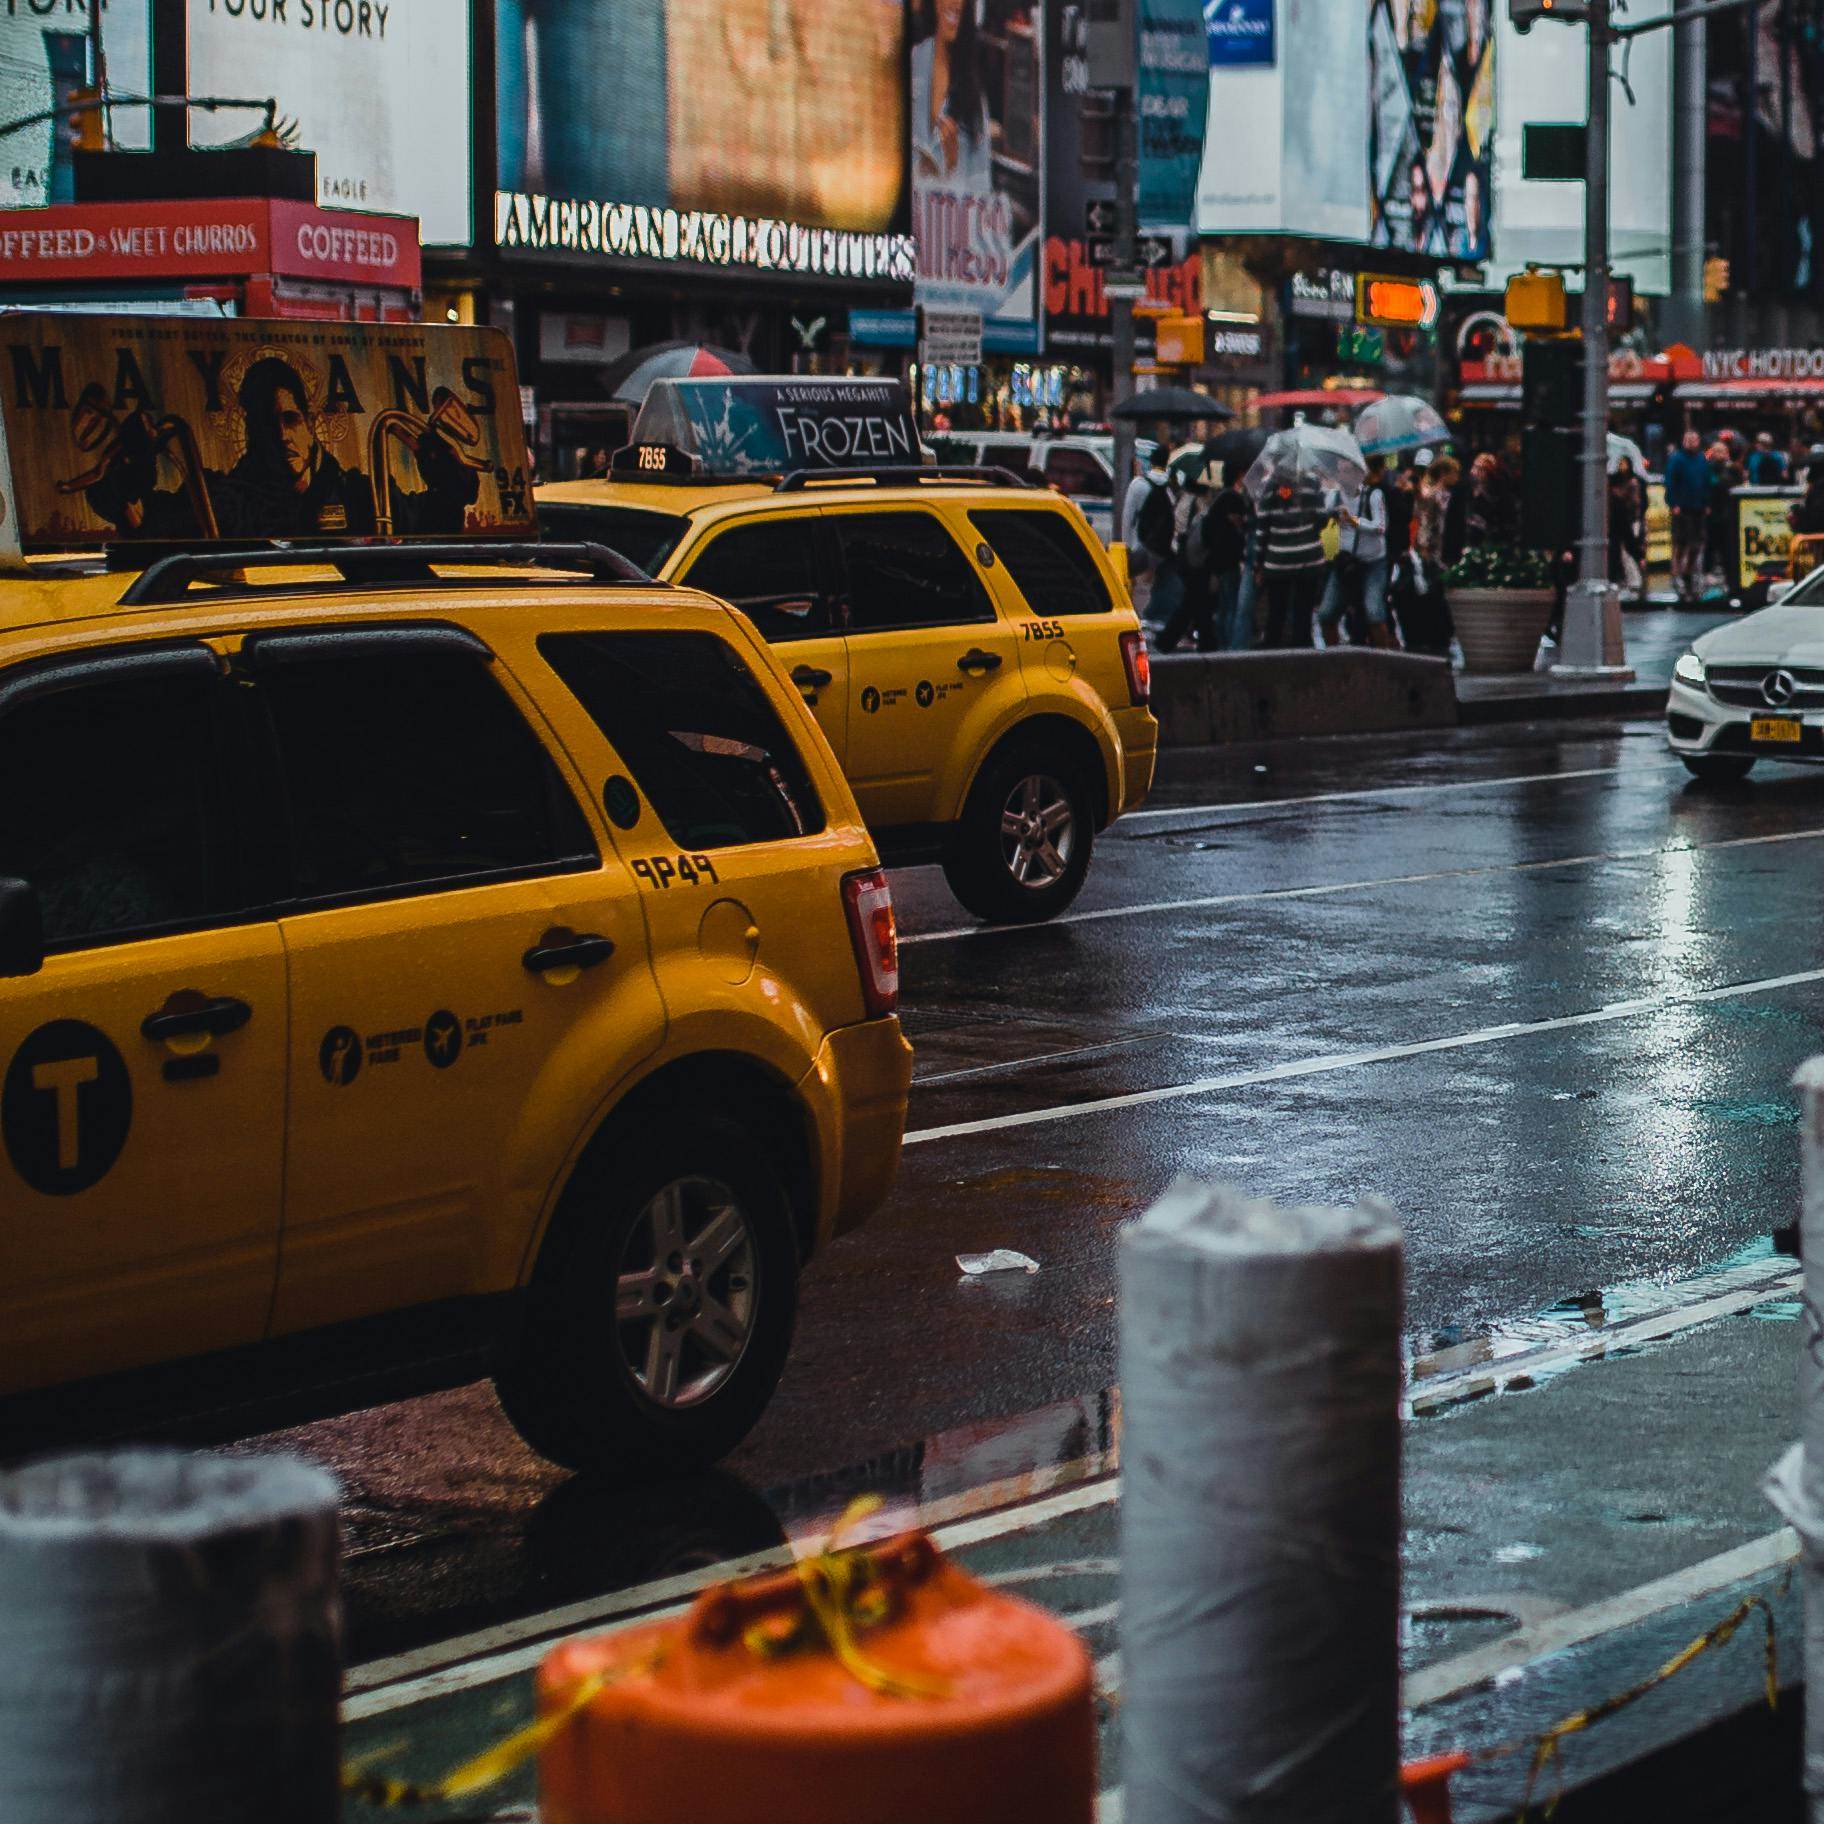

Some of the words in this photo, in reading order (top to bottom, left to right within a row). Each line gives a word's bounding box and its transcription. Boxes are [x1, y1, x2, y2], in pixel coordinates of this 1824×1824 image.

[109, 224, 167, 254] SWEET
[173, 223, 257, 254] CHURROS
[297, 222, 398, 267] COFFEED
[495, 190, 679, 259] AMERICAN
[8, 344, 497, 415] MAYANS
[776, 389, 786, 402] A
[788, 386, 832, 403] SERIOUS
[834, 386, 890, 404] MEGAHIT!
[776, 407, 910, 466] FROZEN
[638, 446, 666, 471] 7B55
[1020, 621, 1065, 642] 7B55
[630, 854, 720, 890] 9P49
[31, 1056, 100, 1169] T
